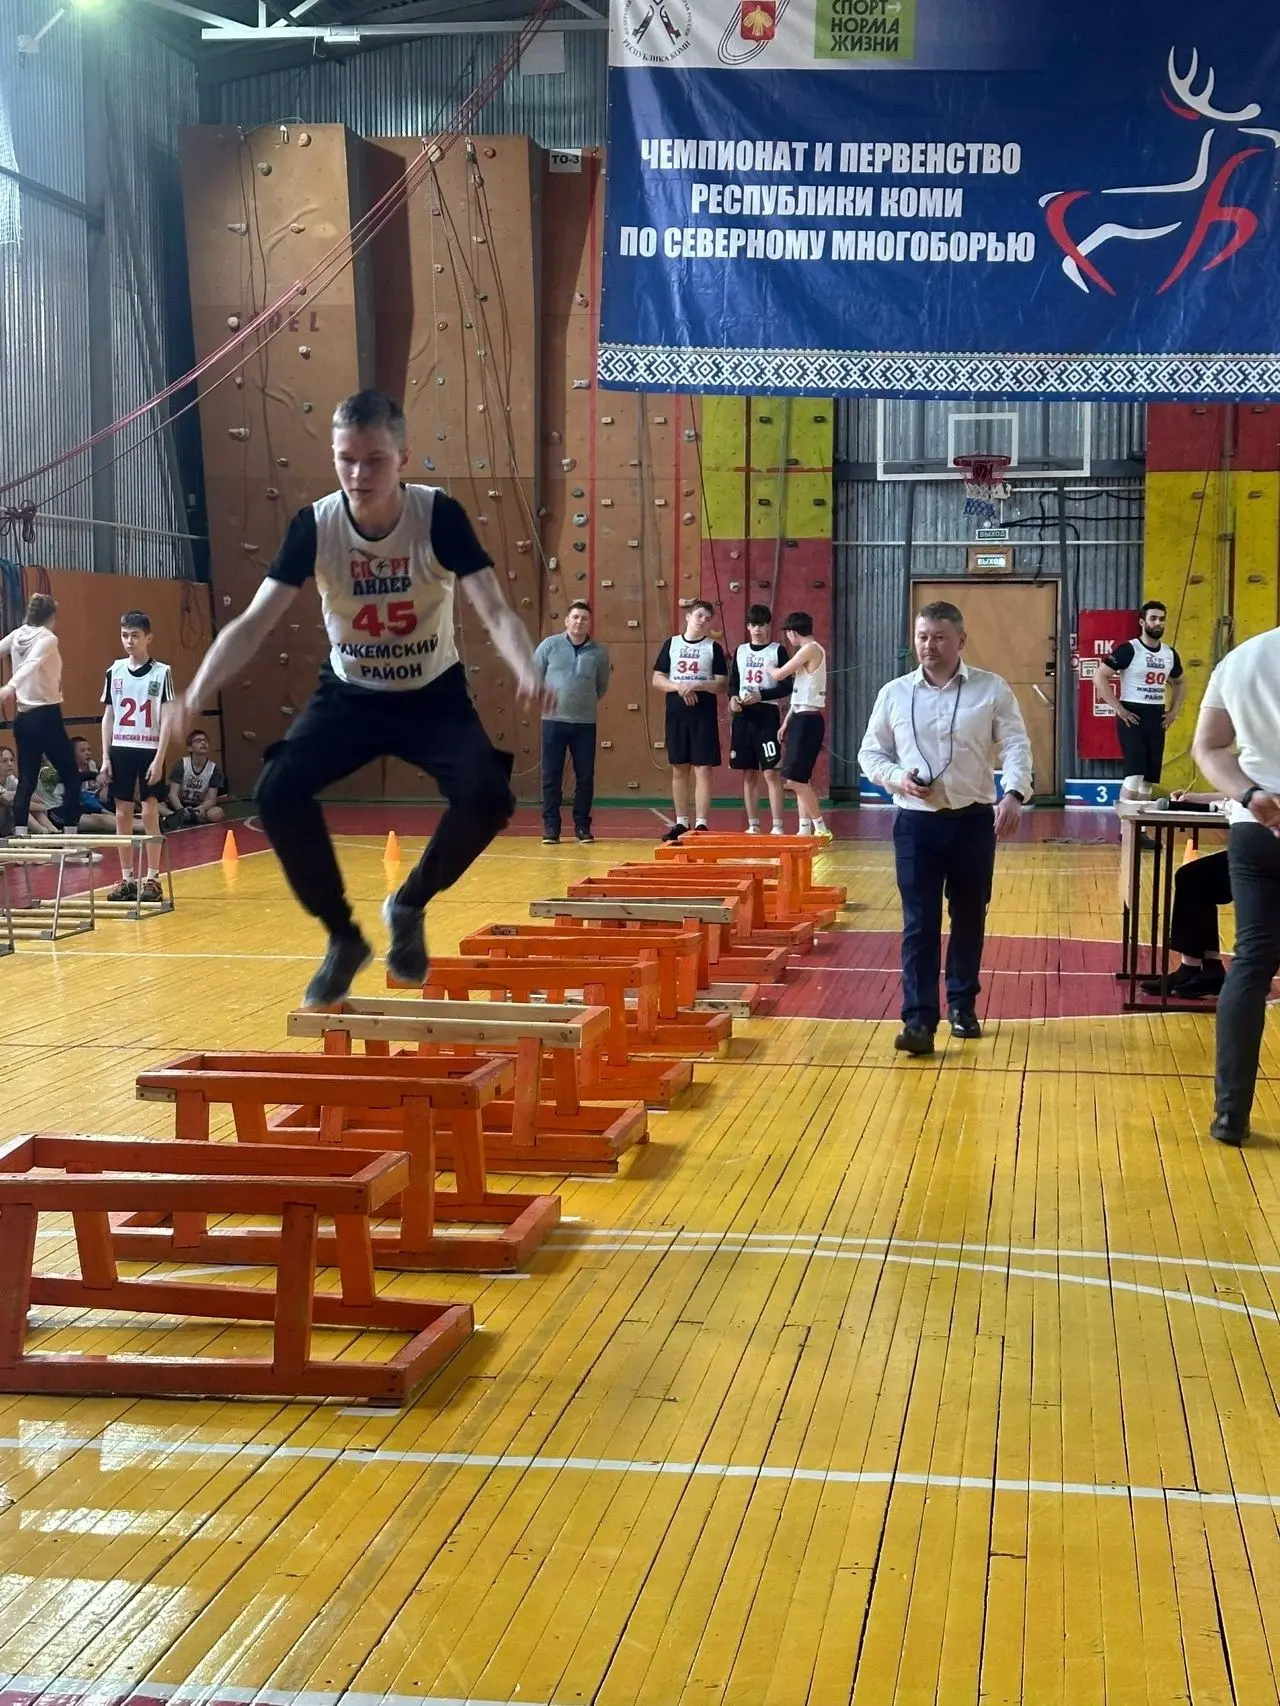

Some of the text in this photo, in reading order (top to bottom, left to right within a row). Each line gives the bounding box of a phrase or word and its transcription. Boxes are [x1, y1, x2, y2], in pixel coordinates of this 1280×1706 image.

[832, 0, 888, 15] СПОРТ
[831, 17, 899, 35] НОРМА
[830, 35, 899, 52] ЖИЗНИ
[641, 139, 1021, 174] ЧЕМПИОНАТ И ПЕРВЕНСТВО
[691, 183, 963, 217] РЕСПУБЛИКИ КОМИ
[620, 226, 1036, 262] ПО СЕВЕРНОМУ МНОГОБОРЬЮ
[353, 576, 412, 595] ЛИДЕР
[352, 600, 418, 637] 45
[1094, 640, 1115, 655] ПК
[361, 663, 422, 680] РАЙОН
[677, 661, 700, 674] 34
[746, 669, 763, 684] 46
[1145, 671, 1166, 685] 80
[119, 697, 152, 728] 21
[762, 741, 777, 758] 10
[1096, 785, 1109, 803] 3
